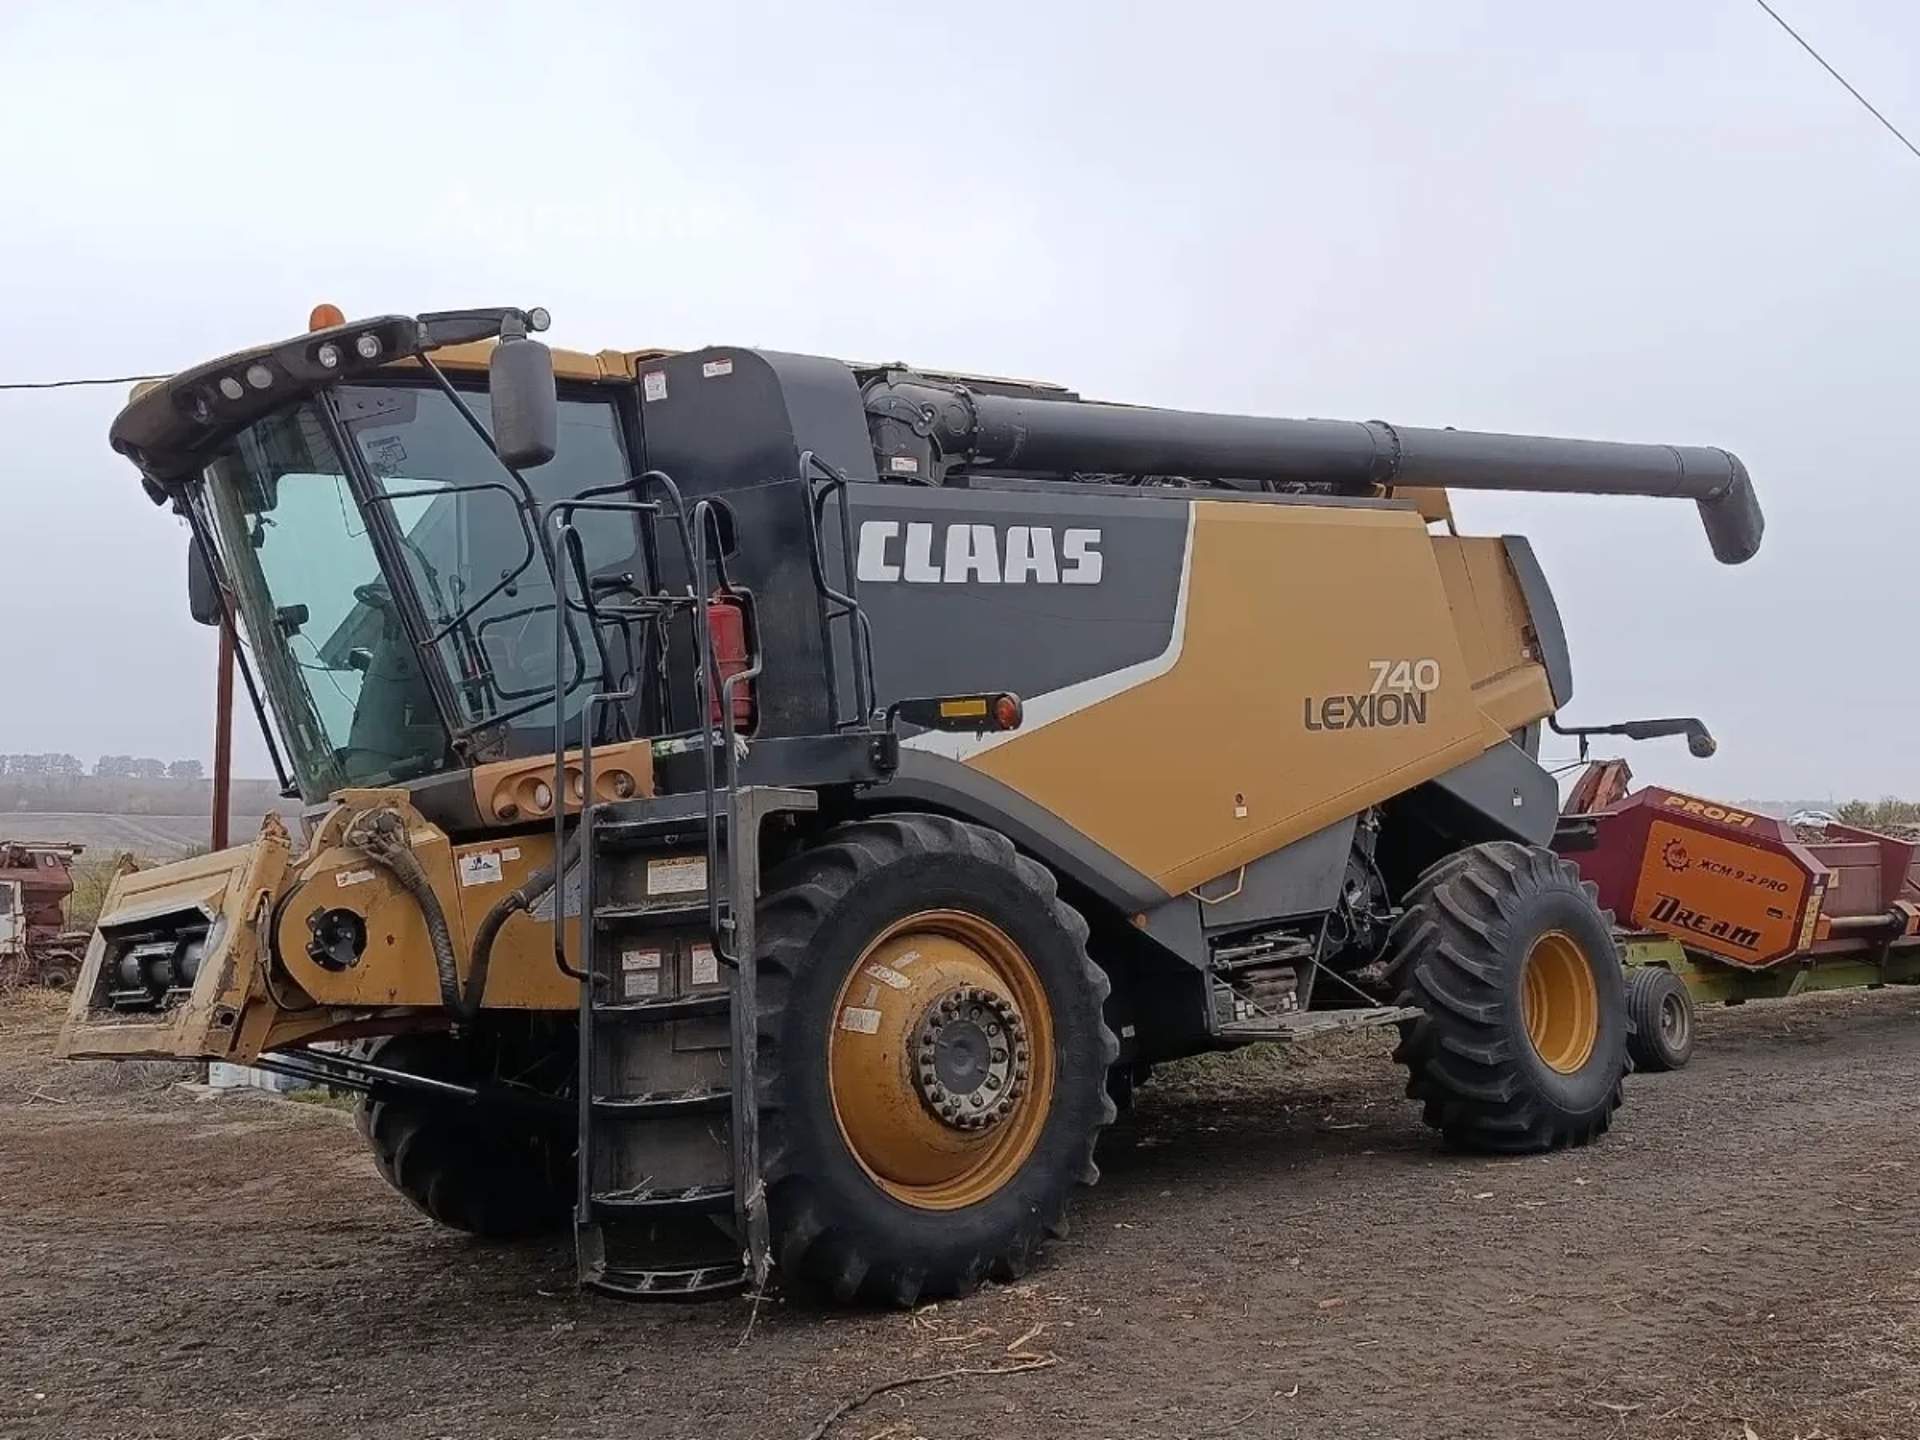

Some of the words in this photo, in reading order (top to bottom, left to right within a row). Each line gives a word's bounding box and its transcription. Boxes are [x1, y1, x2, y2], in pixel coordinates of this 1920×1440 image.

[857, 521, 1103, 584] CLAAS
[1368, 659, 1440, 693] 740
[1304, 692, 1427, 731] LEXION
[1663, 796, 1755, 828] PROFI
[1758, 878, 1789, 893] PRO
